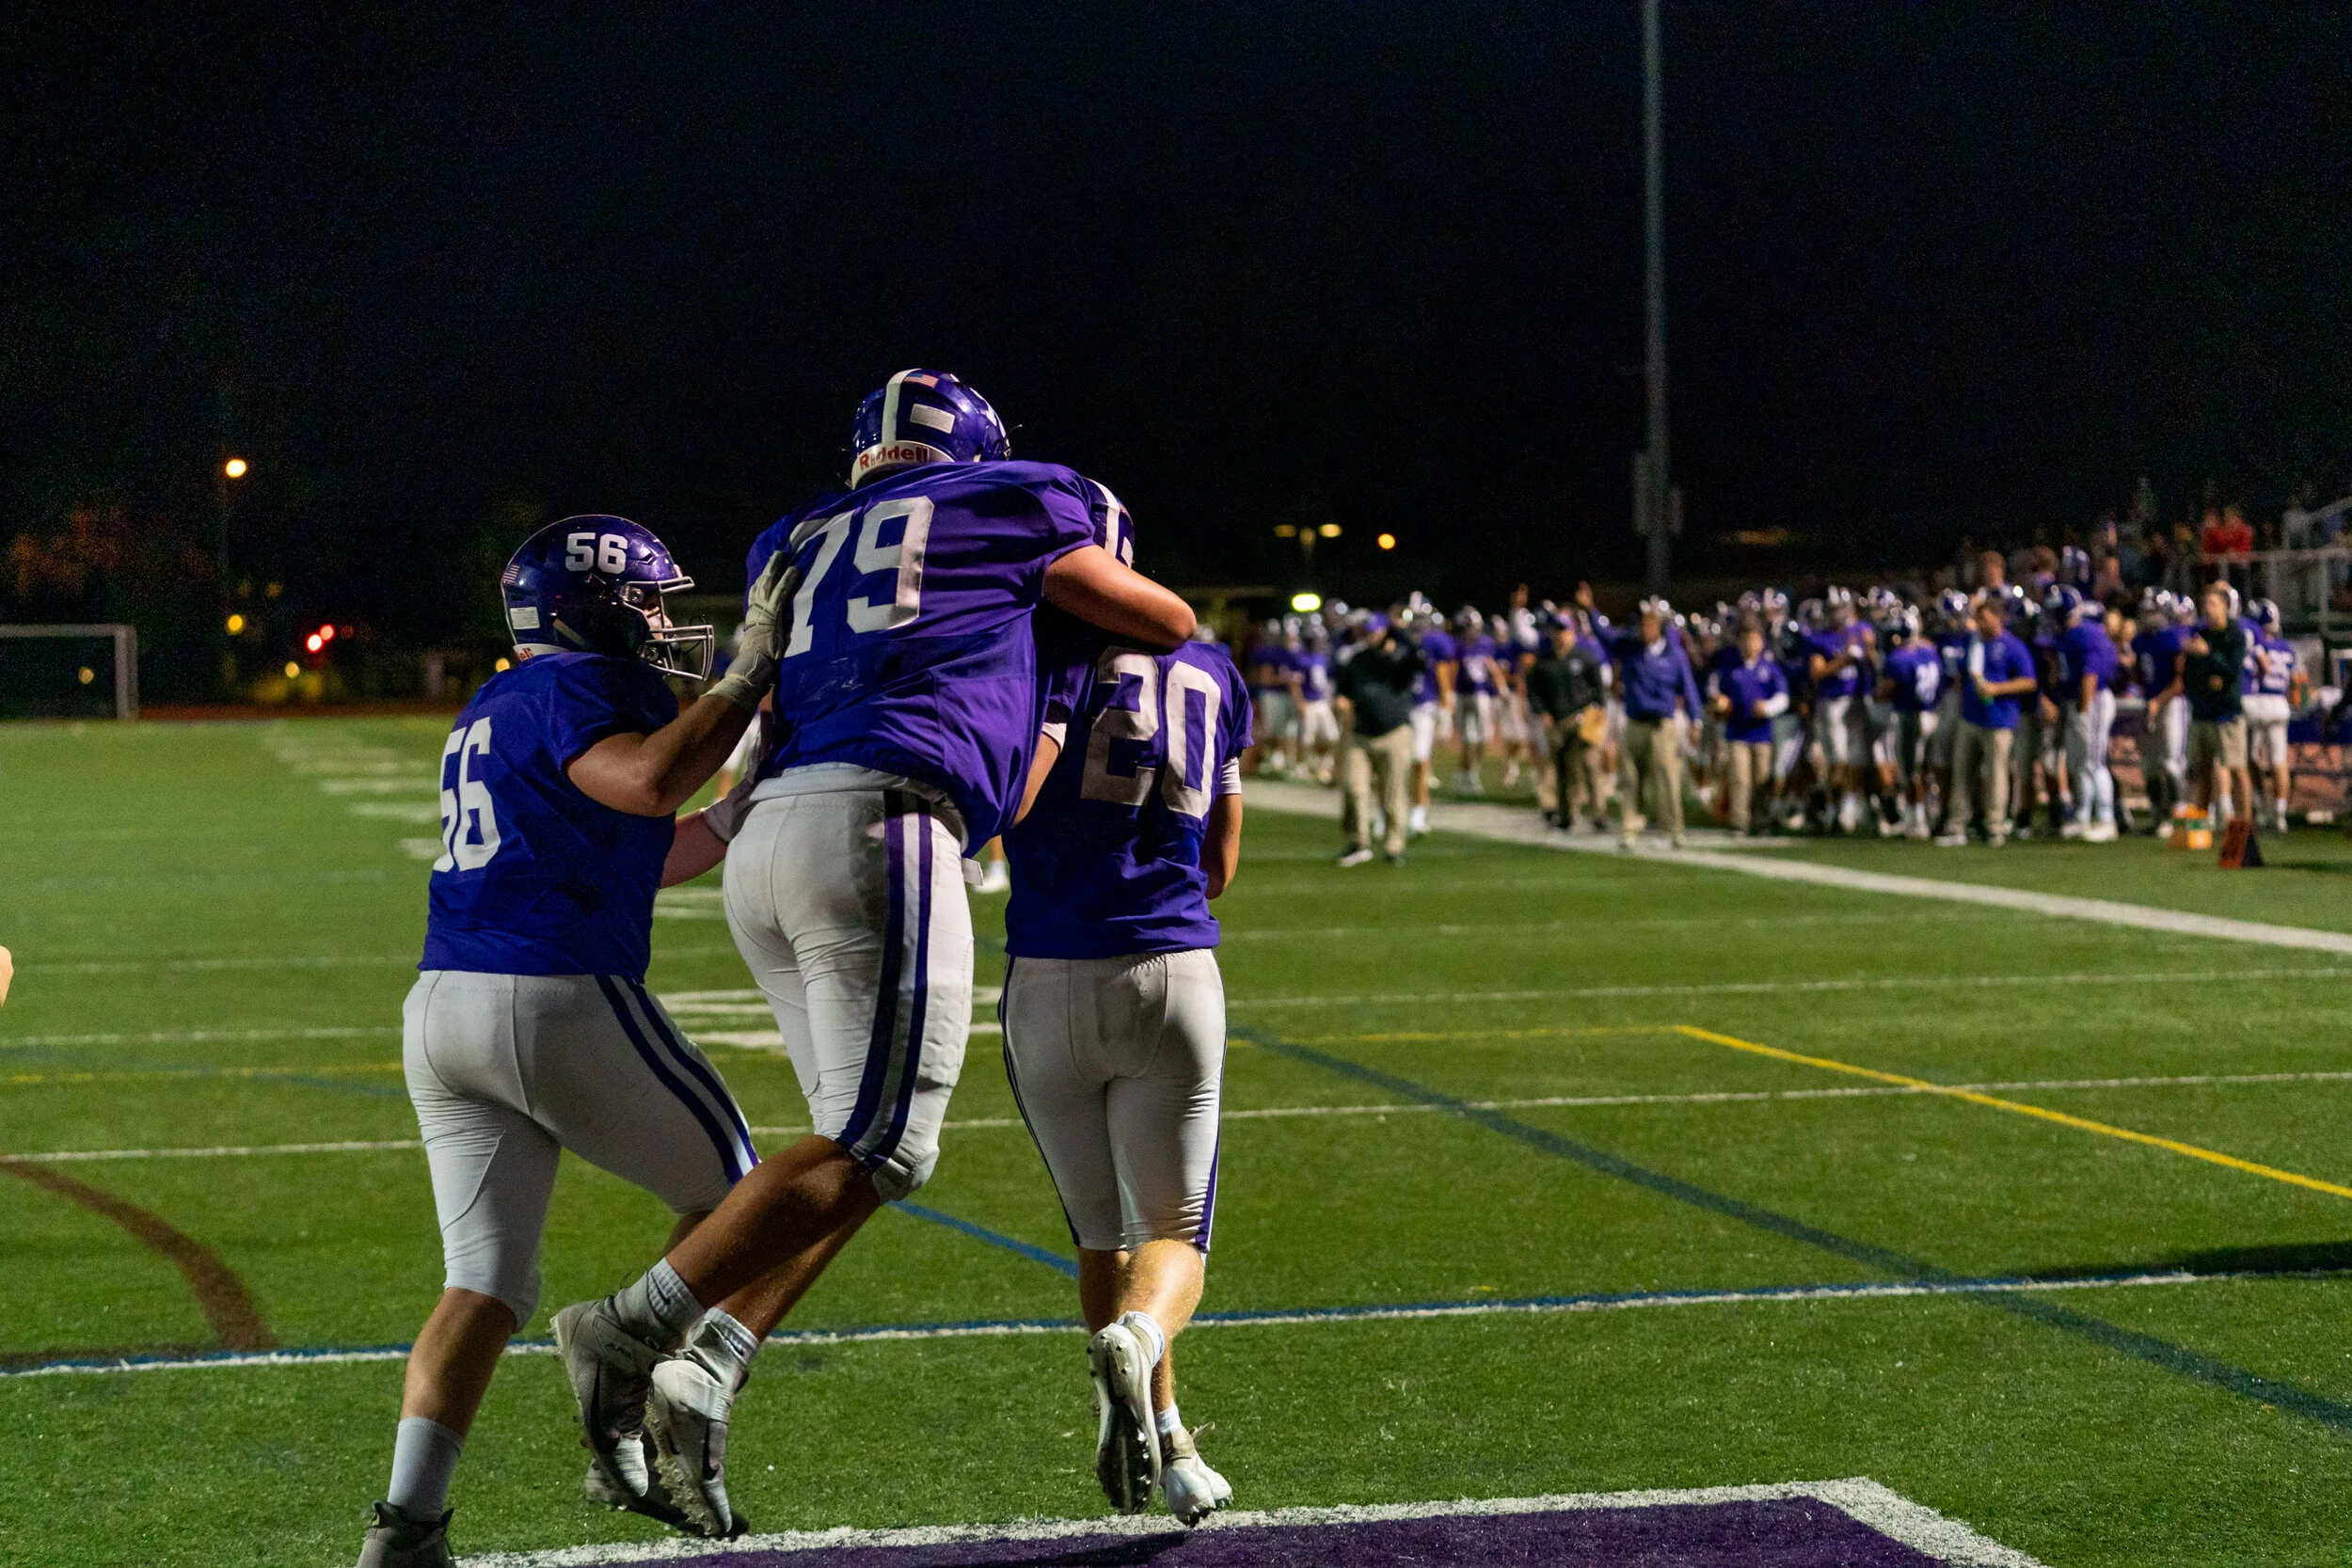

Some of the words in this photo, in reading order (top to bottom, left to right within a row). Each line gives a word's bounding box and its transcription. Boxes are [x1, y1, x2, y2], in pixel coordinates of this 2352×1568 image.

[859, 445, 930, 470] Riddell
[564, 532, 628, 575] 56
[783, 495, 935, 658] 79
[433, 716, 501, 873] 56
[1080, 645, 1221, 821] 20
